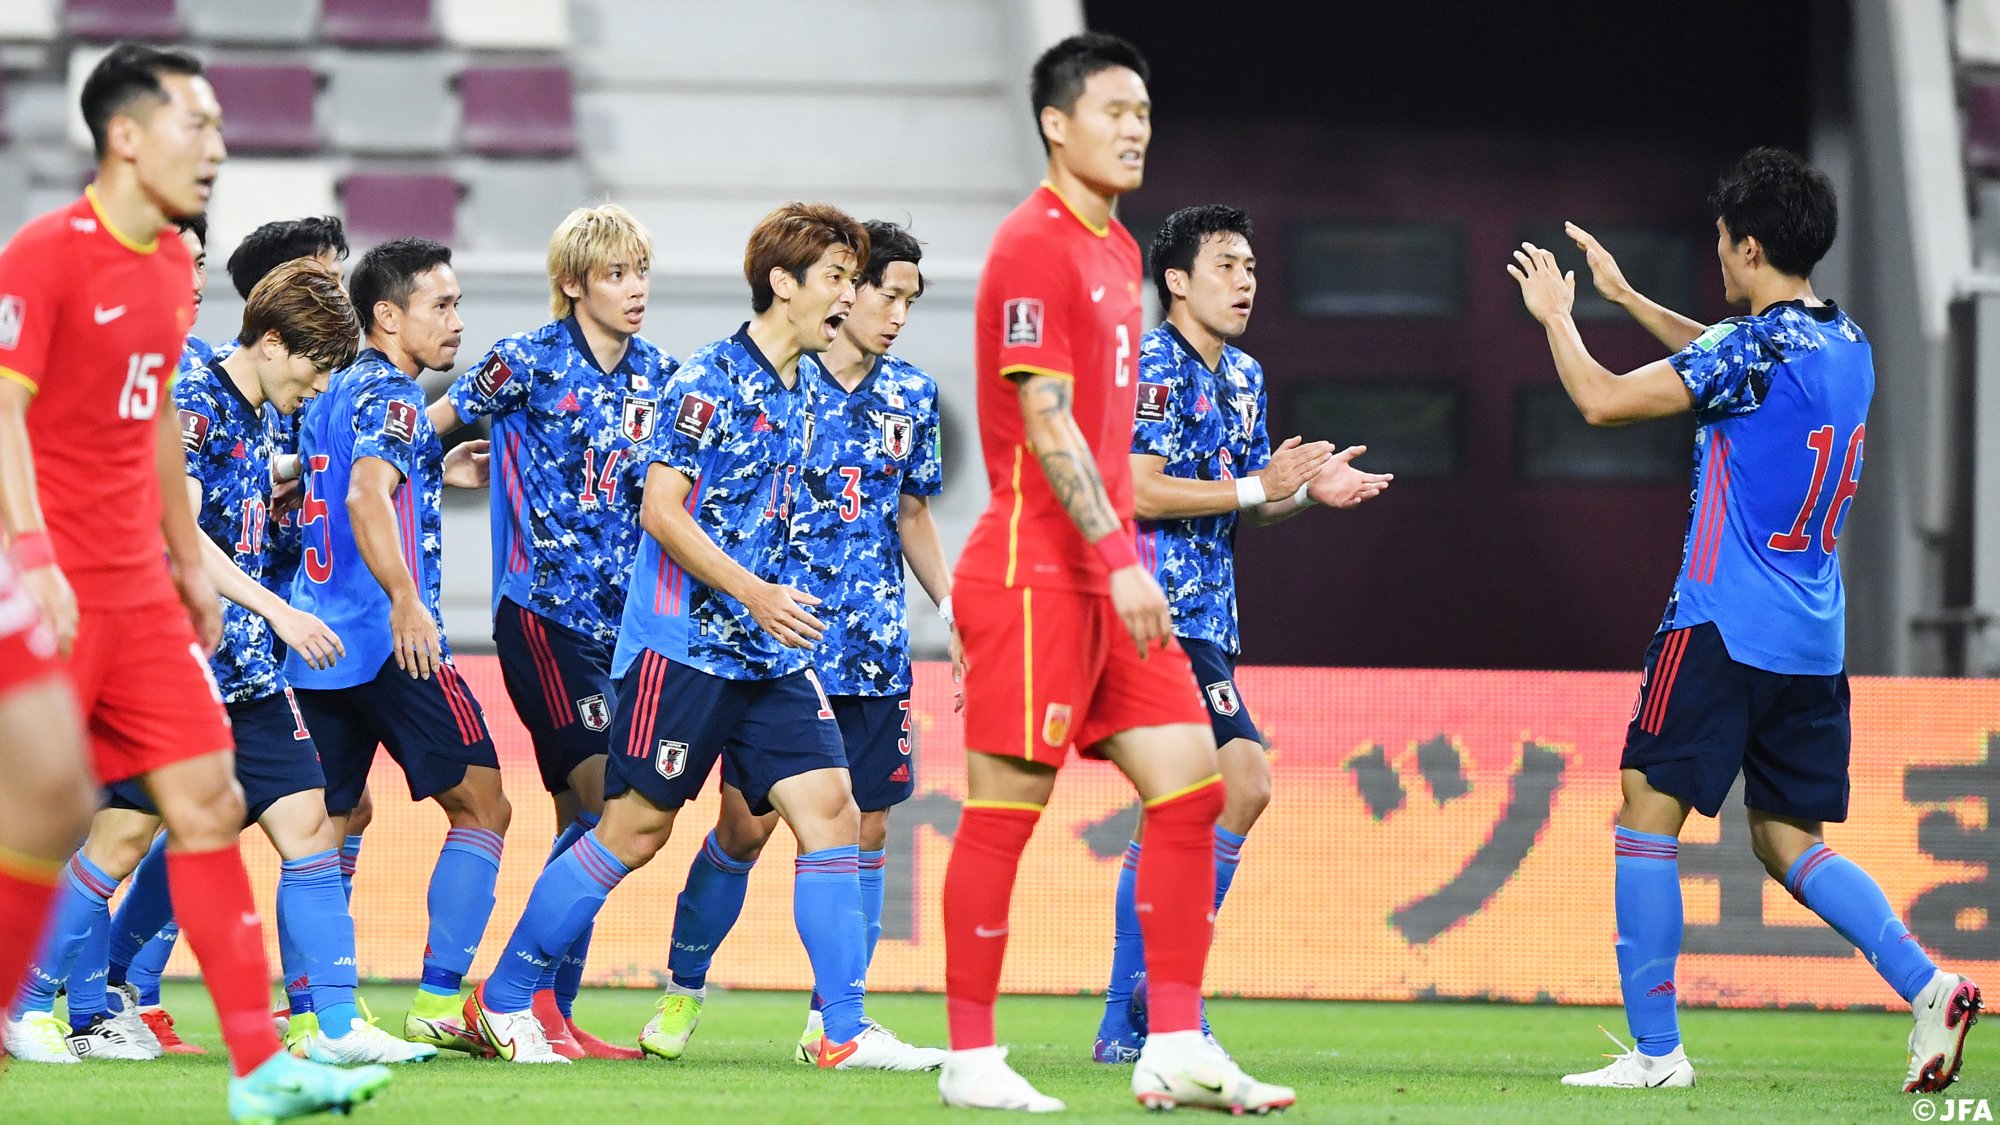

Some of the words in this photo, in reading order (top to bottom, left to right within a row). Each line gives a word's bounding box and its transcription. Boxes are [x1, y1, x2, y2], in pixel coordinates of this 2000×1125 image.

[1114, 324, 1130, 388] 2
[118, 352, 165, 420] 15
[579, 447, 619, 505] 14
[765, 464, 796, 520] 15
[839, 466, 861, 523] 3
[1767, 423, 1866, 555] 16
[235, 498, 266, 555] 18
[302, 455, 333, 584] 5
[898, 699, 912, 755] 3
[672, 937, 709, 952] PAN
